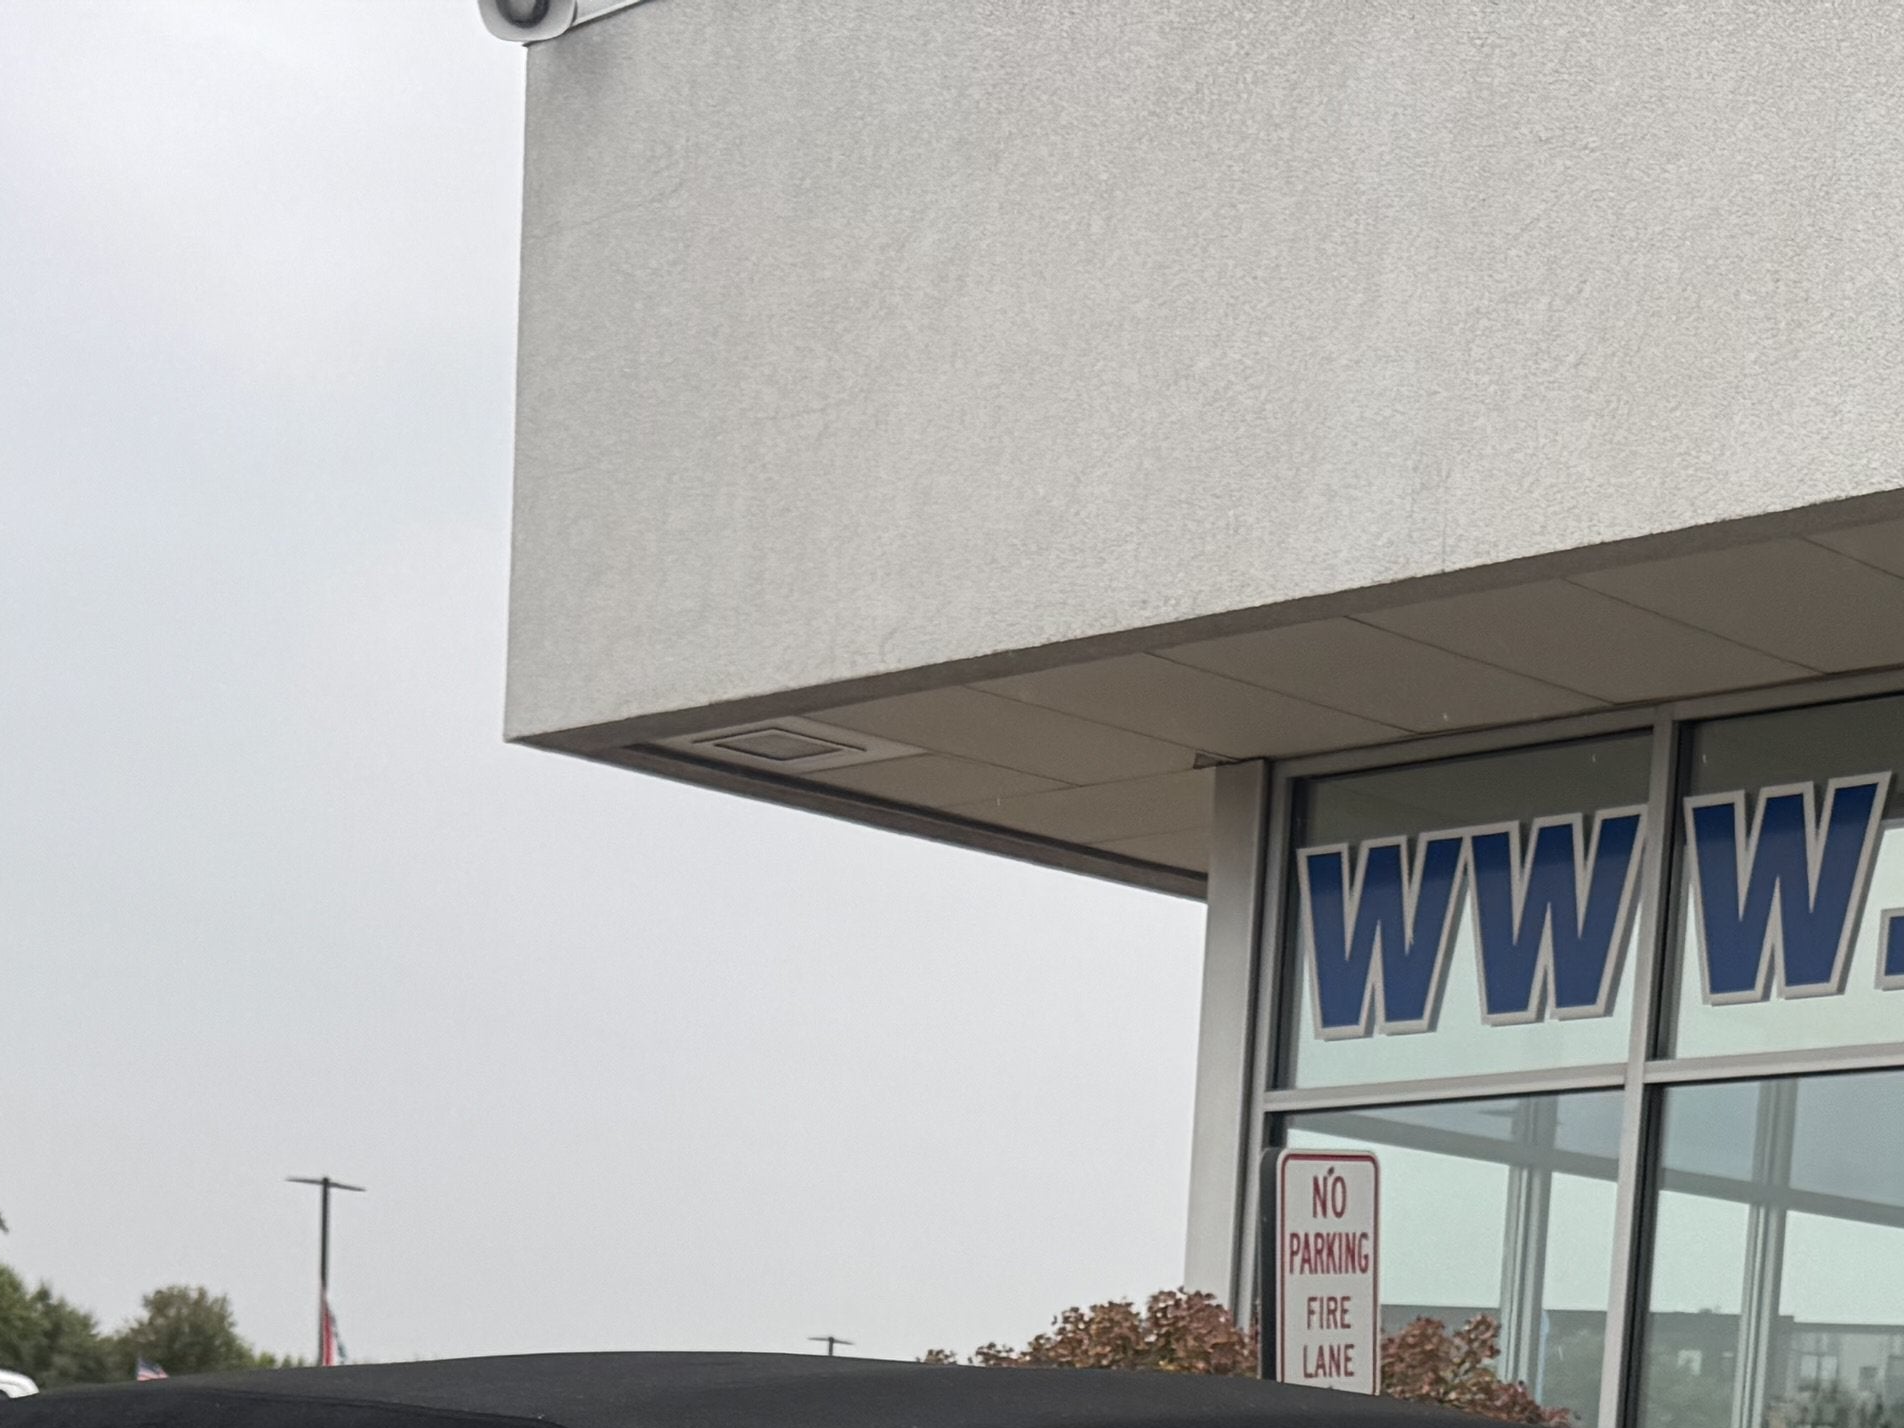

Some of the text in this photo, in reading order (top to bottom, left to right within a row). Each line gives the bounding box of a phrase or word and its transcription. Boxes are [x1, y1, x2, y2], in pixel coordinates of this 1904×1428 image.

[1312, 1175, 1348, 1219] NO
[1289, 1232, 1369, 1275] PARKING
[1307, 1296, 1352, 1330] FIRE
[1303, 1343, 1355, 1379] LANE
